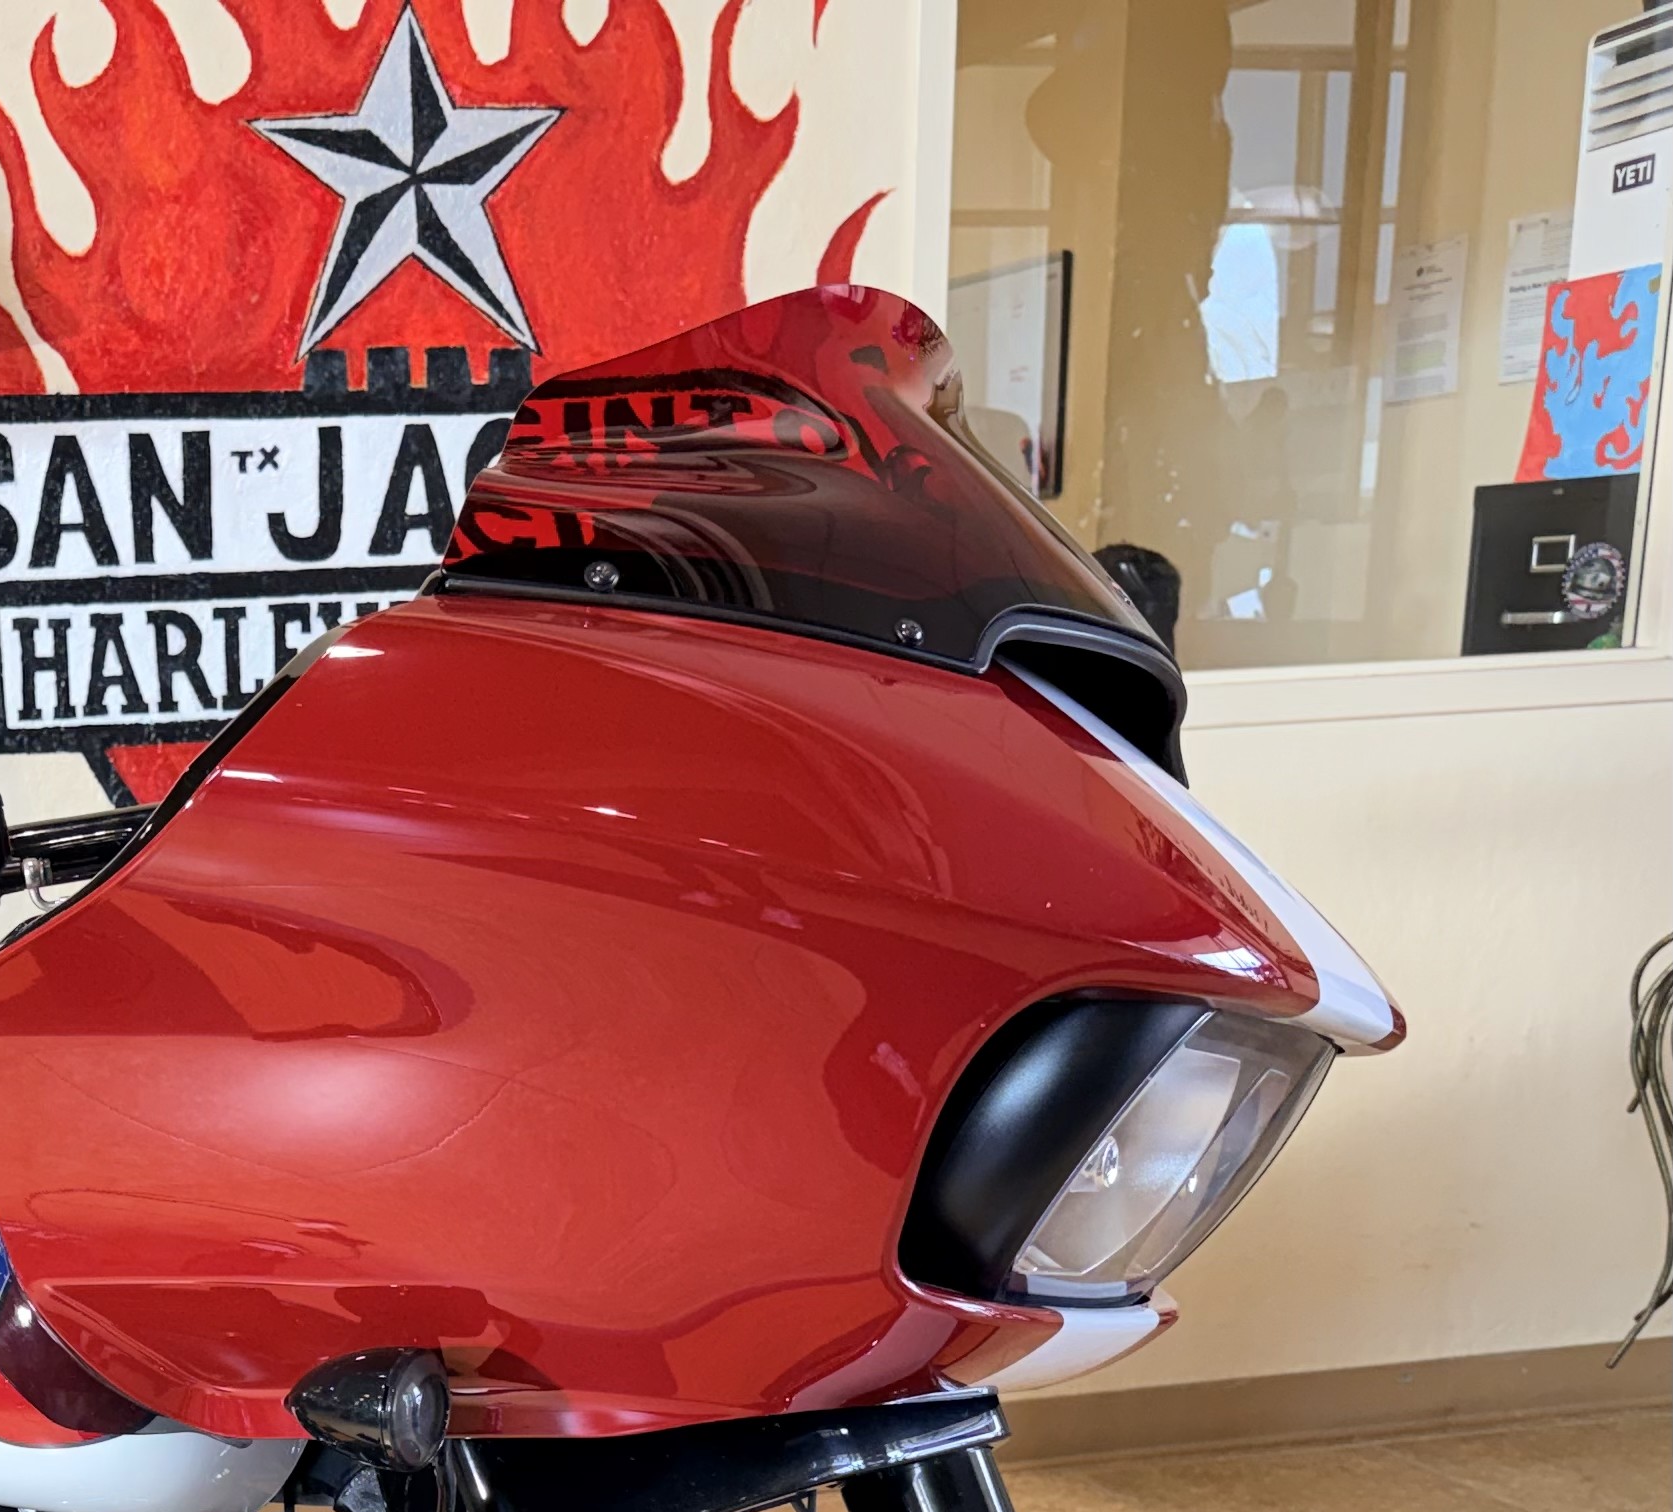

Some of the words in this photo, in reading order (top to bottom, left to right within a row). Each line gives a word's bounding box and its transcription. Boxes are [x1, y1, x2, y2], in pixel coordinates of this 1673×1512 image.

[1616, 160, 1652, 188] YETI
[231, 445, 280, 473] TX
[12, 600, 383, 721] HARLE
